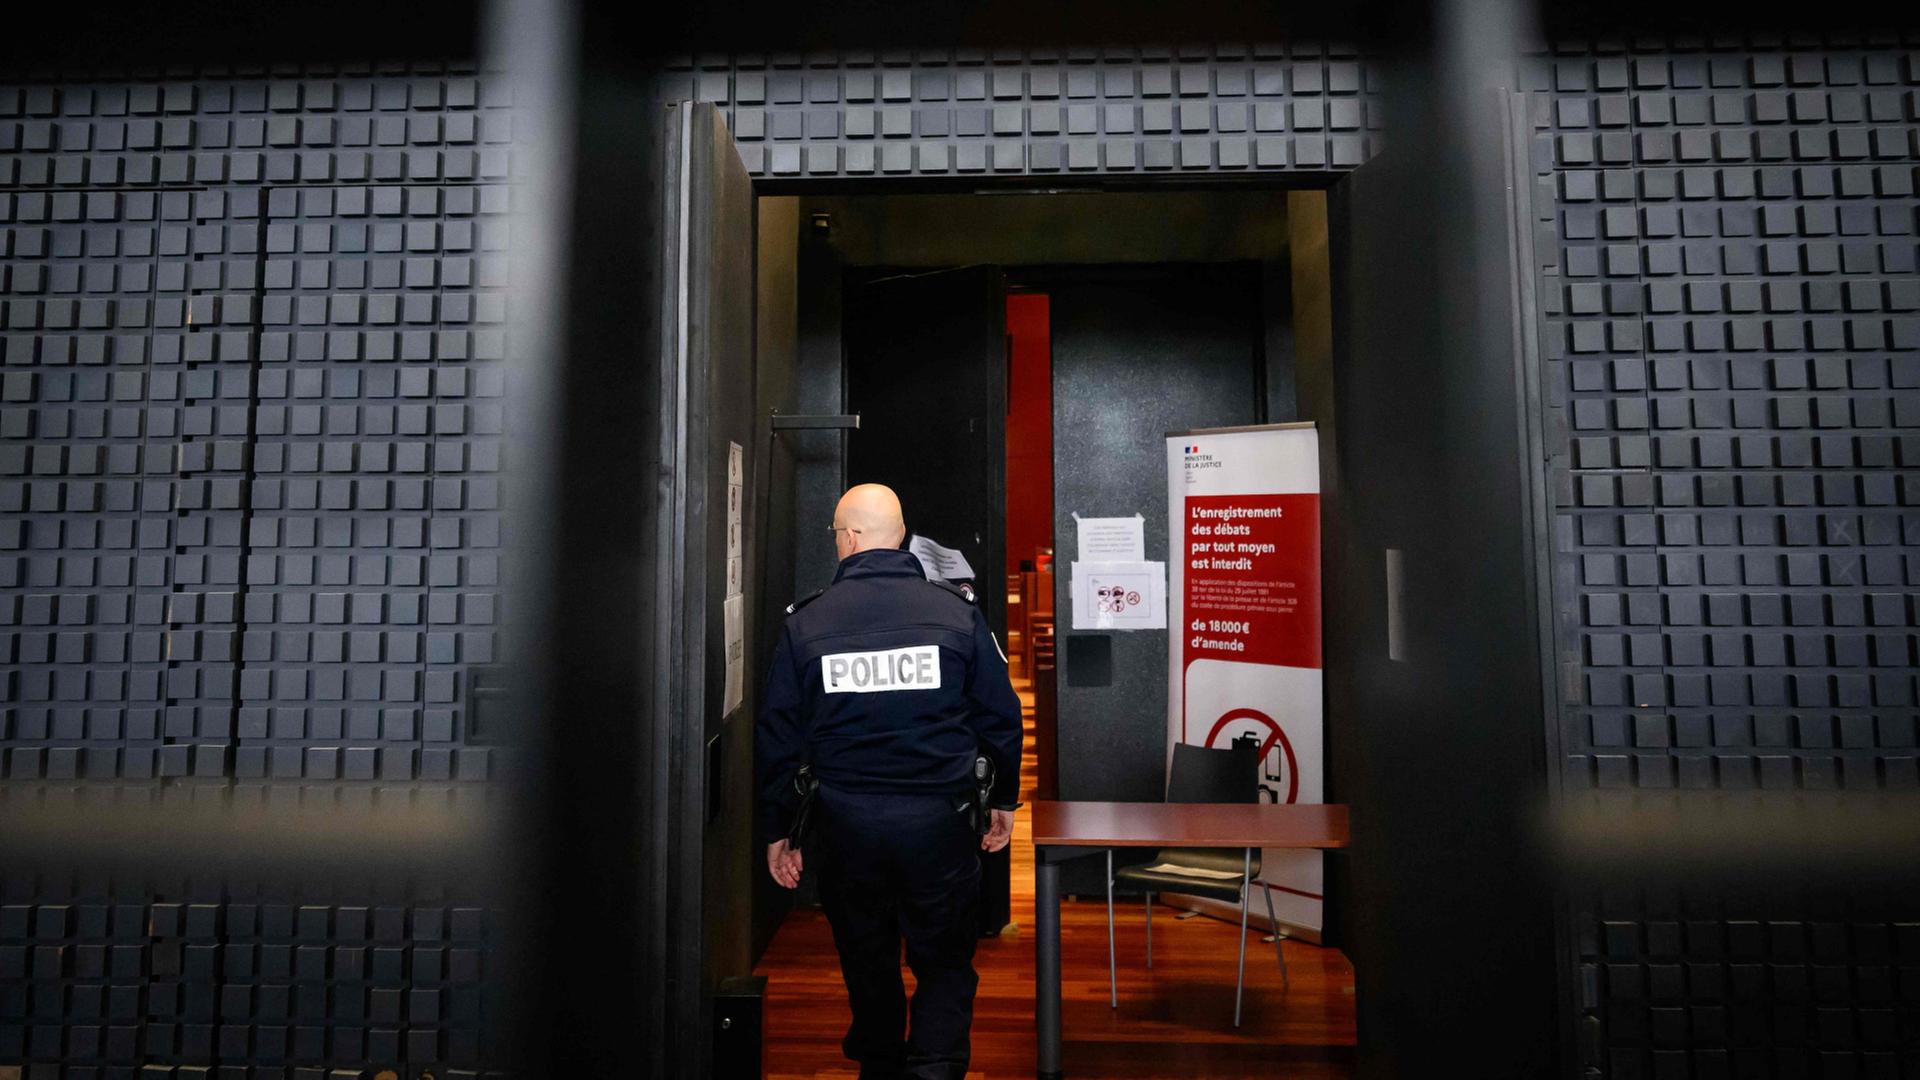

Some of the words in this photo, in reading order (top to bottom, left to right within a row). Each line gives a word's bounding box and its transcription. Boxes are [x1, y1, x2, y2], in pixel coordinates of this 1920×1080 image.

[1192, 506, 1282, 520] L'enregistrement
[1192, 523, 1211, 535] des
[1214, 523, 1250, 535] débats
[1192, 542, 1211, 555] par
[1213, 542, 1235, 552] tout
[1238, 543, 1275, 556] moyen
[1192, 558, 1208, 569] est
[1212, 557, 1252, 570] interdit
[1192, 619, 1206, 631] de
[1192, 636, 1244, 652] d'amende
[829, 652, 933, 687] POLICE
